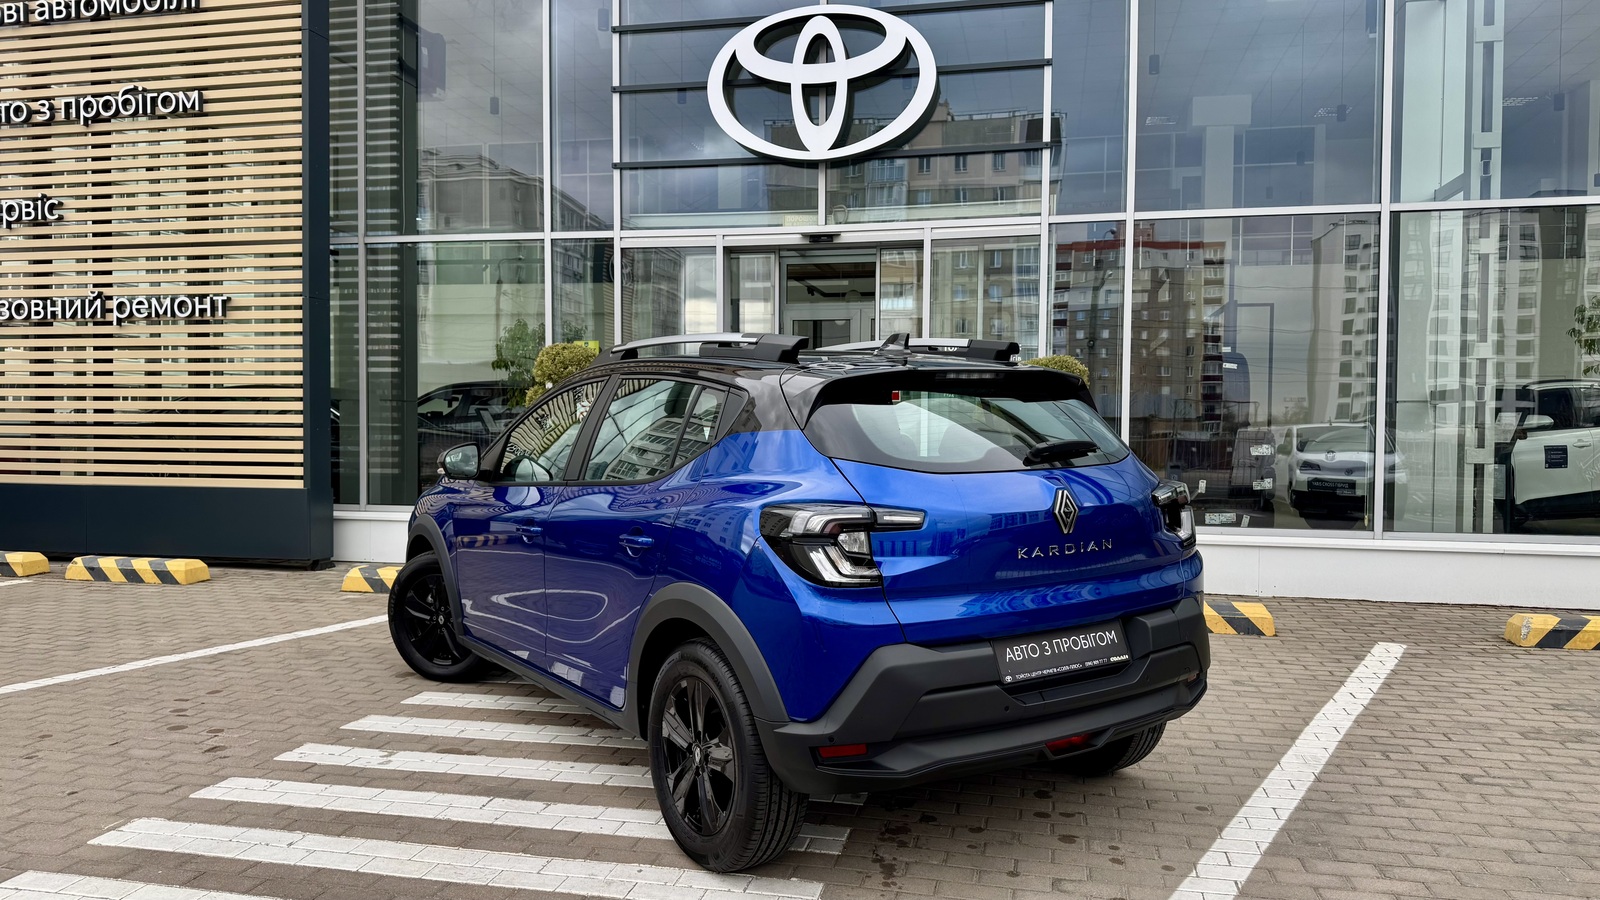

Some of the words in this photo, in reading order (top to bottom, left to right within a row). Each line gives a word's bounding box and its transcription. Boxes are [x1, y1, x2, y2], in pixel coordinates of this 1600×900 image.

[0, 1, 24, 23] ві
[34, 0, 197, 21] автомол
[36, 100, 51, 121] з
[61, 85, 201, 127] пробігом
[113, 296, 229, 326] ремонт
[1017, 538, 1112, 559] KARDIAN
[1006, 643, 1040, 662] АВТО
[1052, 630, 1118, 653] ПРОБІГОМ
